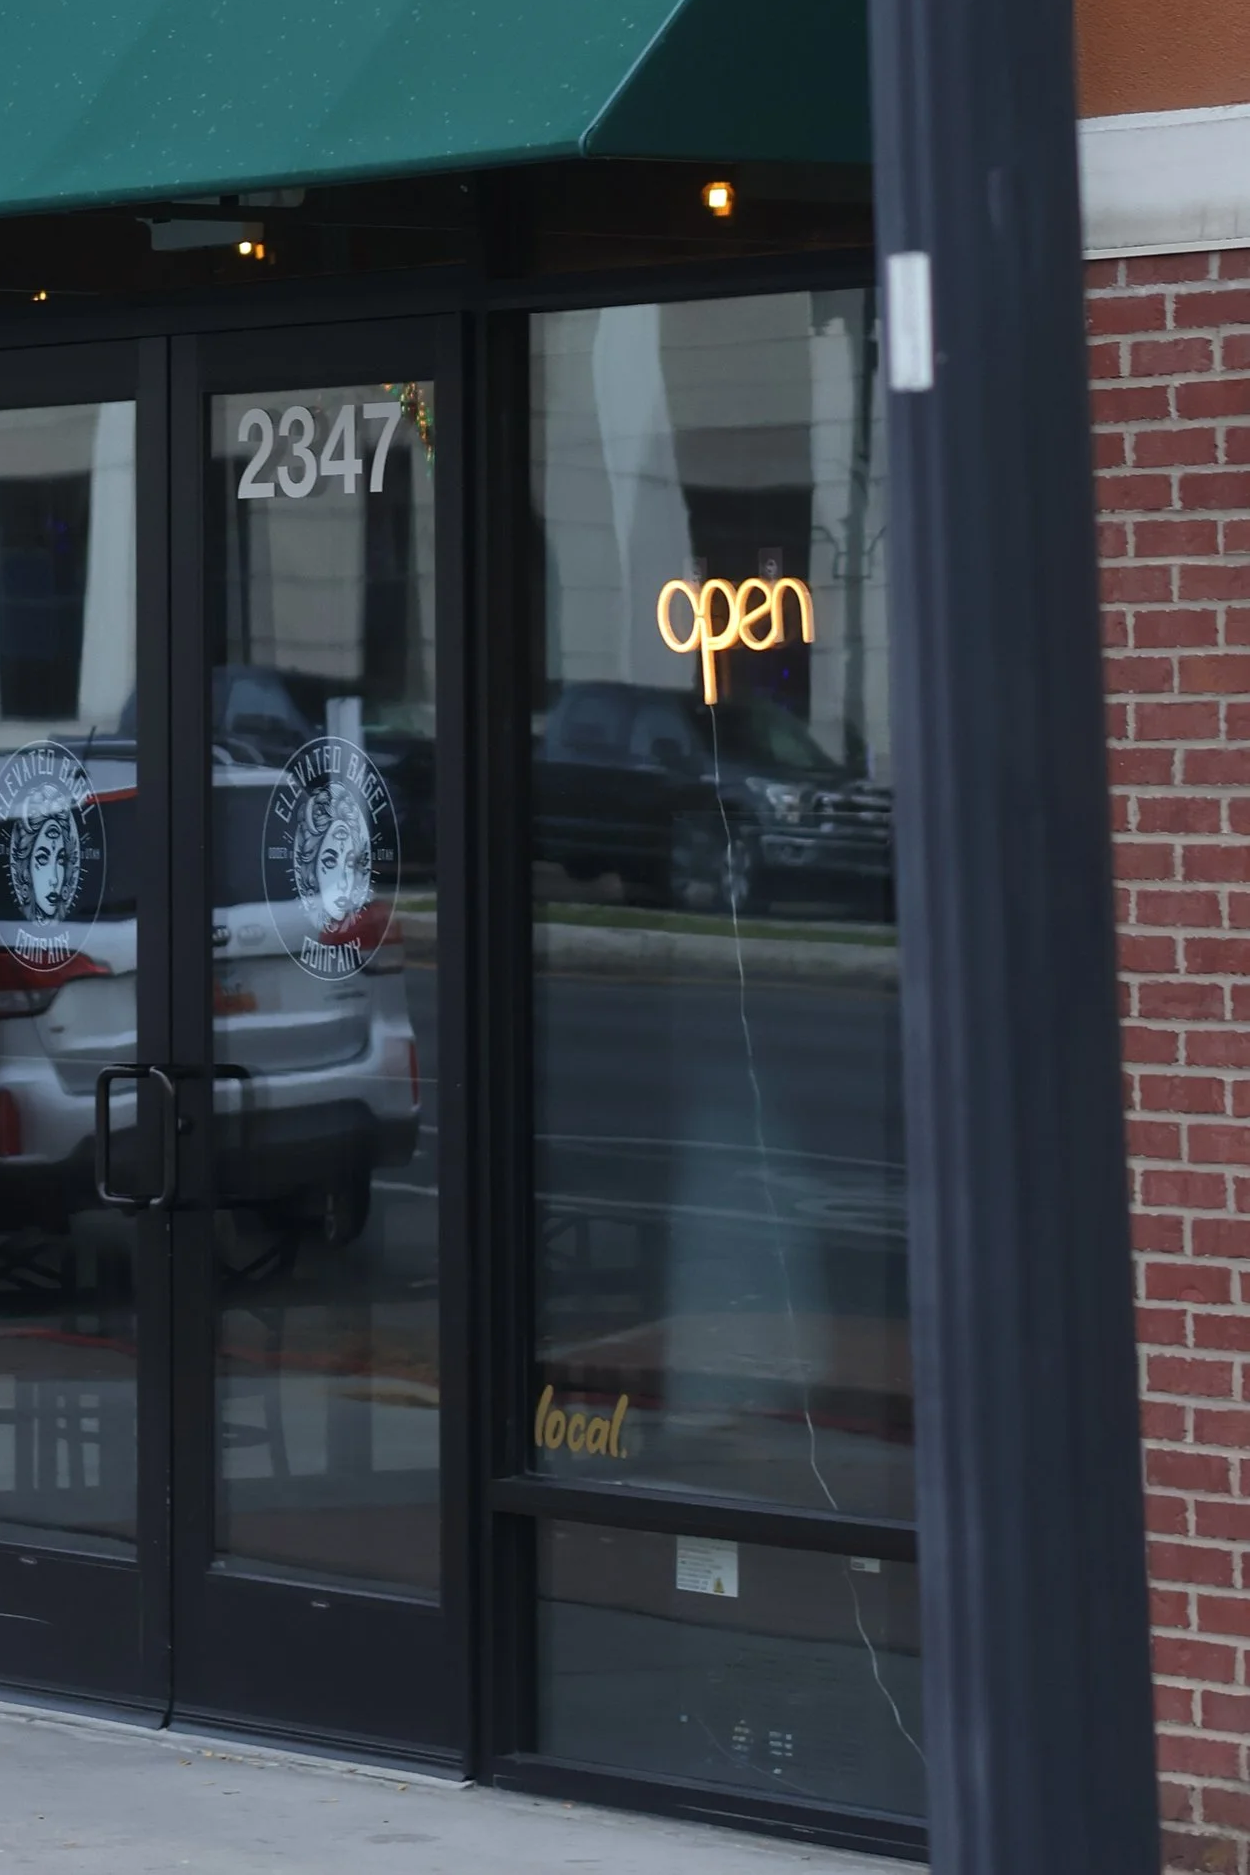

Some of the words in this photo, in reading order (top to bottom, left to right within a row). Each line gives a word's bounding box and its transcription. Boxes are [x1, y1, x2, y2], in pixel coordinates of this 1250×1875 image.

[237, 401, 402, 500] 2347
[656, 576, 815, 706] open
[59, 756, 96, 825] BAGEL
[274, 745, 342, 824] ELEVATED
[346, 752, 388, 825] BAGEL
[14, 928, 72, 965] COMPANY
[299, 935, 363, 973] COMPANY
